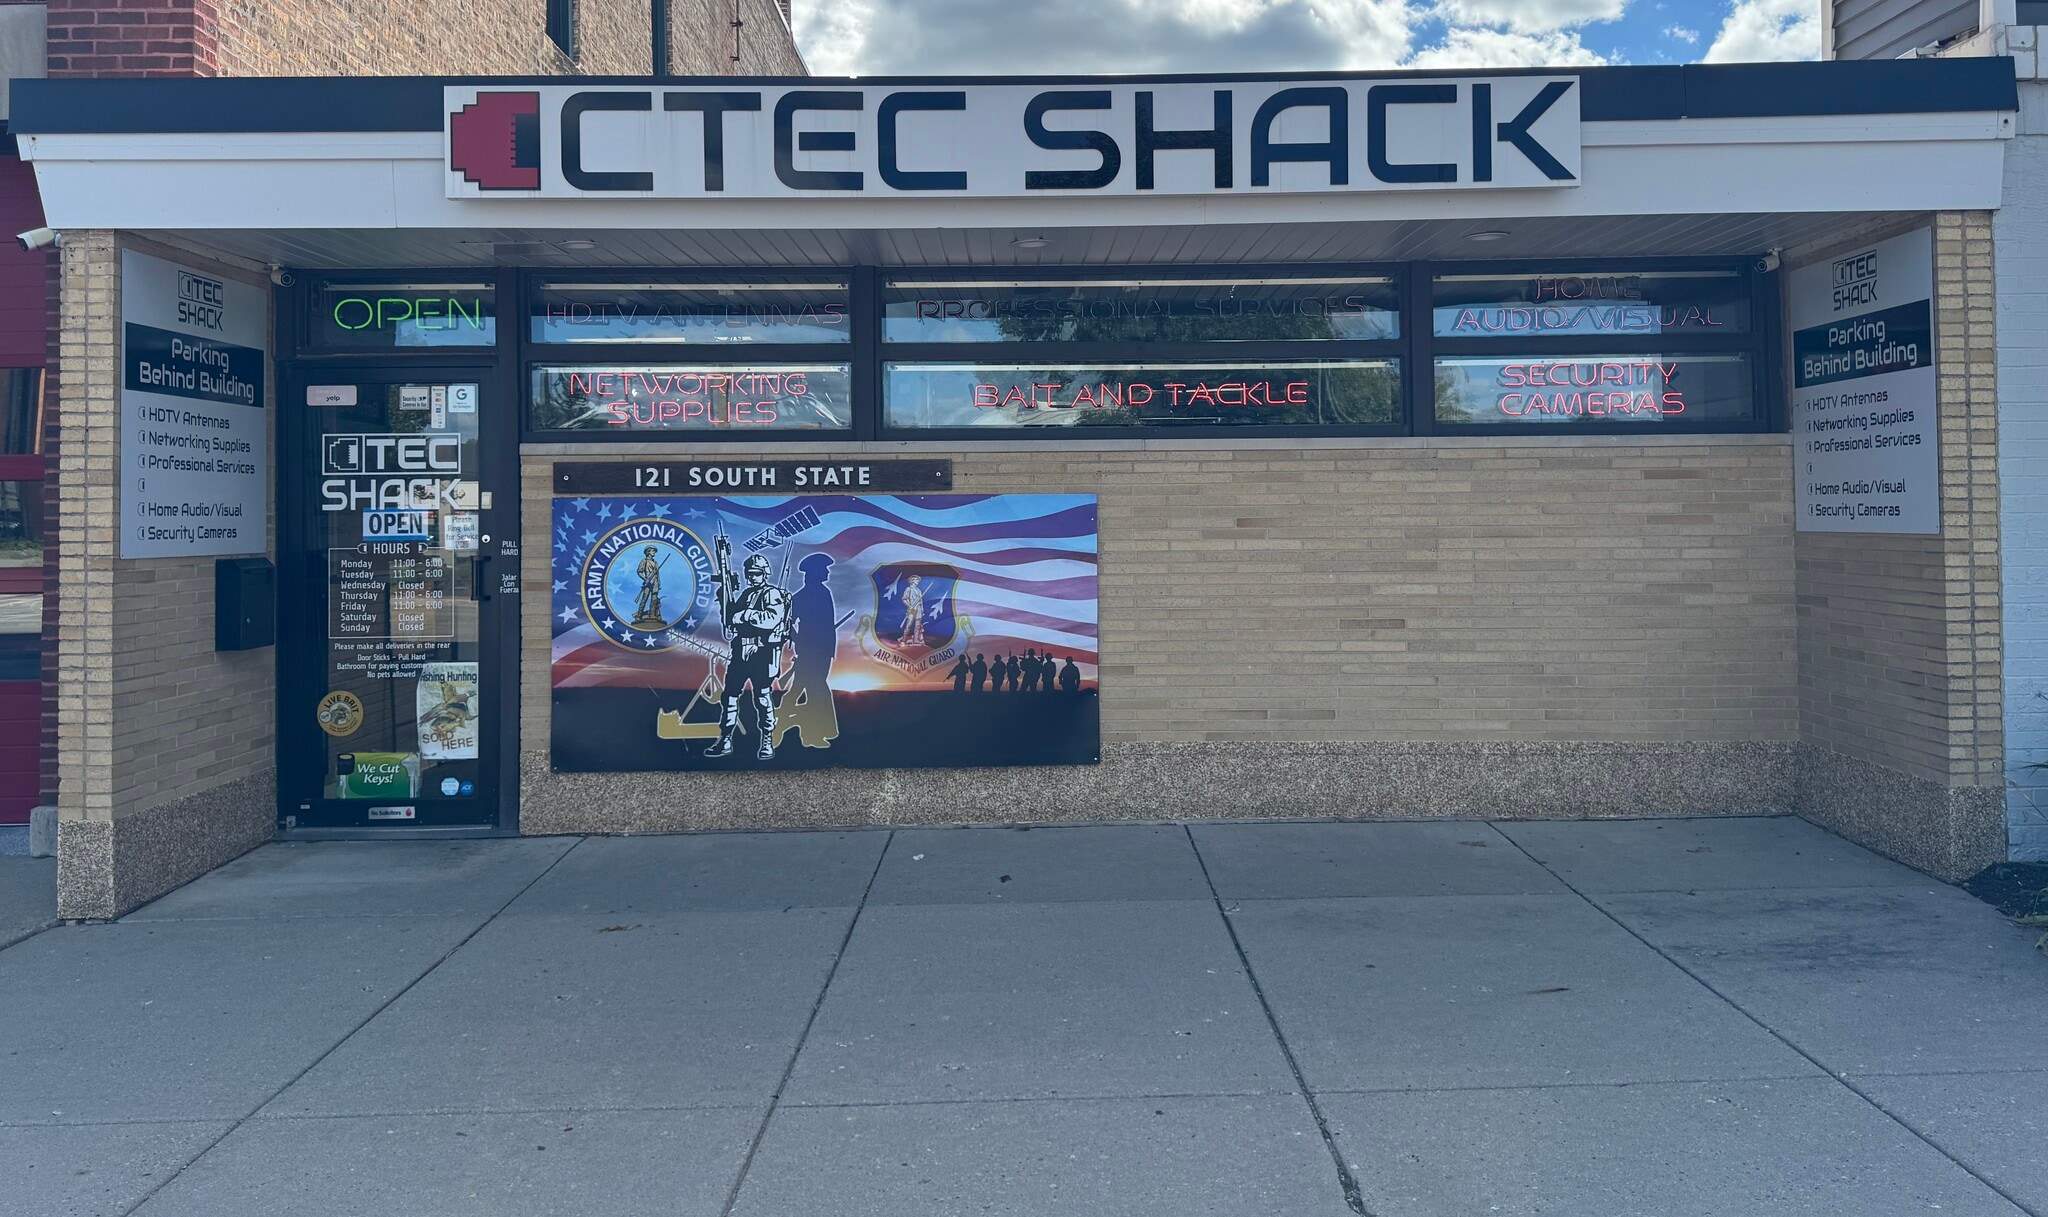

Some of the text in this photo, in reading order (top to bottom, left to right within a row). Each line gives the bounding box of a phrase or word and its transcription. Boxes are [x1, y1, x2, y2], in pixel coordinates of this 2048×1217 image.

[561, 81, 1577, 191] CTEC SHACK
[1536, 276, 1640, 299] HOME
[1833, 279, 1878, 311] SHACK
[178, 301, 223, 331] SHACK
[334, 298, 480, 330] OPEN
[547, 302, 844, 325] HDTV ANTENNAS
[1456, 306, 1722, 330] AUDIO/VISUAL
[1828, 319, 1886, 348] Parking
[172, 338, 229, 374] Parking
[1804, 341, 1917, 379] Behind Building
[139, 361, 254, 404] Behind Building
[570, 372, 807, 396] NETWORKING
[1503, 362, 1678, 387] SECURITY
[973, 381, 1308, 408] BAIT AND TACKLE
[1501, 392, 1686, 415] CAMERAS
[1812, 390, 1888, 411] HDTV Antennas
[149, 407, 230, 429] HDTV Antennas
[607, 400, 778, 425] SUPPLIES
[1813, 408, 1914, 432] Networking Supplies
[148, 431, 251, 454] Networking Supplies
[1813, 432, 1921, 453] Professional Services
[148, 455, 255, 474] Professional Services
[366, 438, 458, 470] TEC
[635, 466, 871, 487] 121 SOUTH STATE
[1815, 478, 1906, 495] Home Audio/Visual
[322, 478, 462, 511] SHACK
[148, 502, 242, 517] Home Audio/Visual
[1815, 502, 1901, 520] Security Cameras
[148, 525, 237, 543] Security Cameras
[368, 513, 423, 534] OPEN
[447, 524, 461, 532] Ring
[373, 542, 411, 554] HOURS
[501, 548, 518, 556] HARD
[341, 559, 373, 569] Monday
[393, 559, 415, 568] 11:00
[425, 558, 443, 567] 6:00
[587, 523, 712, 610] ARMY NATIONAL GUARD
[341, 569, 374, 580] Tuesday
[393, 569, 415, 578] 11:00
[425, 569, 443, 578] 6:00
[341, 581, 425, 590] Wednesday Closed
[341, 591, 378, 601] Thursday
[394, 591, 415, 600] 11:00
[425, 590, 443, 599] 6:00
[341, 602, 367, 612] Friday
[394, 601, 415, 610] 11:00
[425, 600, 443, 609] 6:00
[341, 612, 424, 622] Saturday Closed
[341, 622, 424, 633] Sunday Closed
[375, 642, 384, 650] all
[385, 642, 415, 650] deliveries
[373, 653, 390, 661] Sticks
[398, 653, 410, 661] Pull
[379, 662, 400, 671] paying
[873, 647, 955, 677] AIR NATIONAL GUARD
[377, 671, 391, 679] pets
[392, 670, 416, 678] allowed
[447, 670, 477, 684] Hunting
[324, 694, 341, 708] LIVE
[442, 737, 474, 750] HERE
[357, 763, 400, 773] We Cut
[363, 773, 394, 785] Keys!
